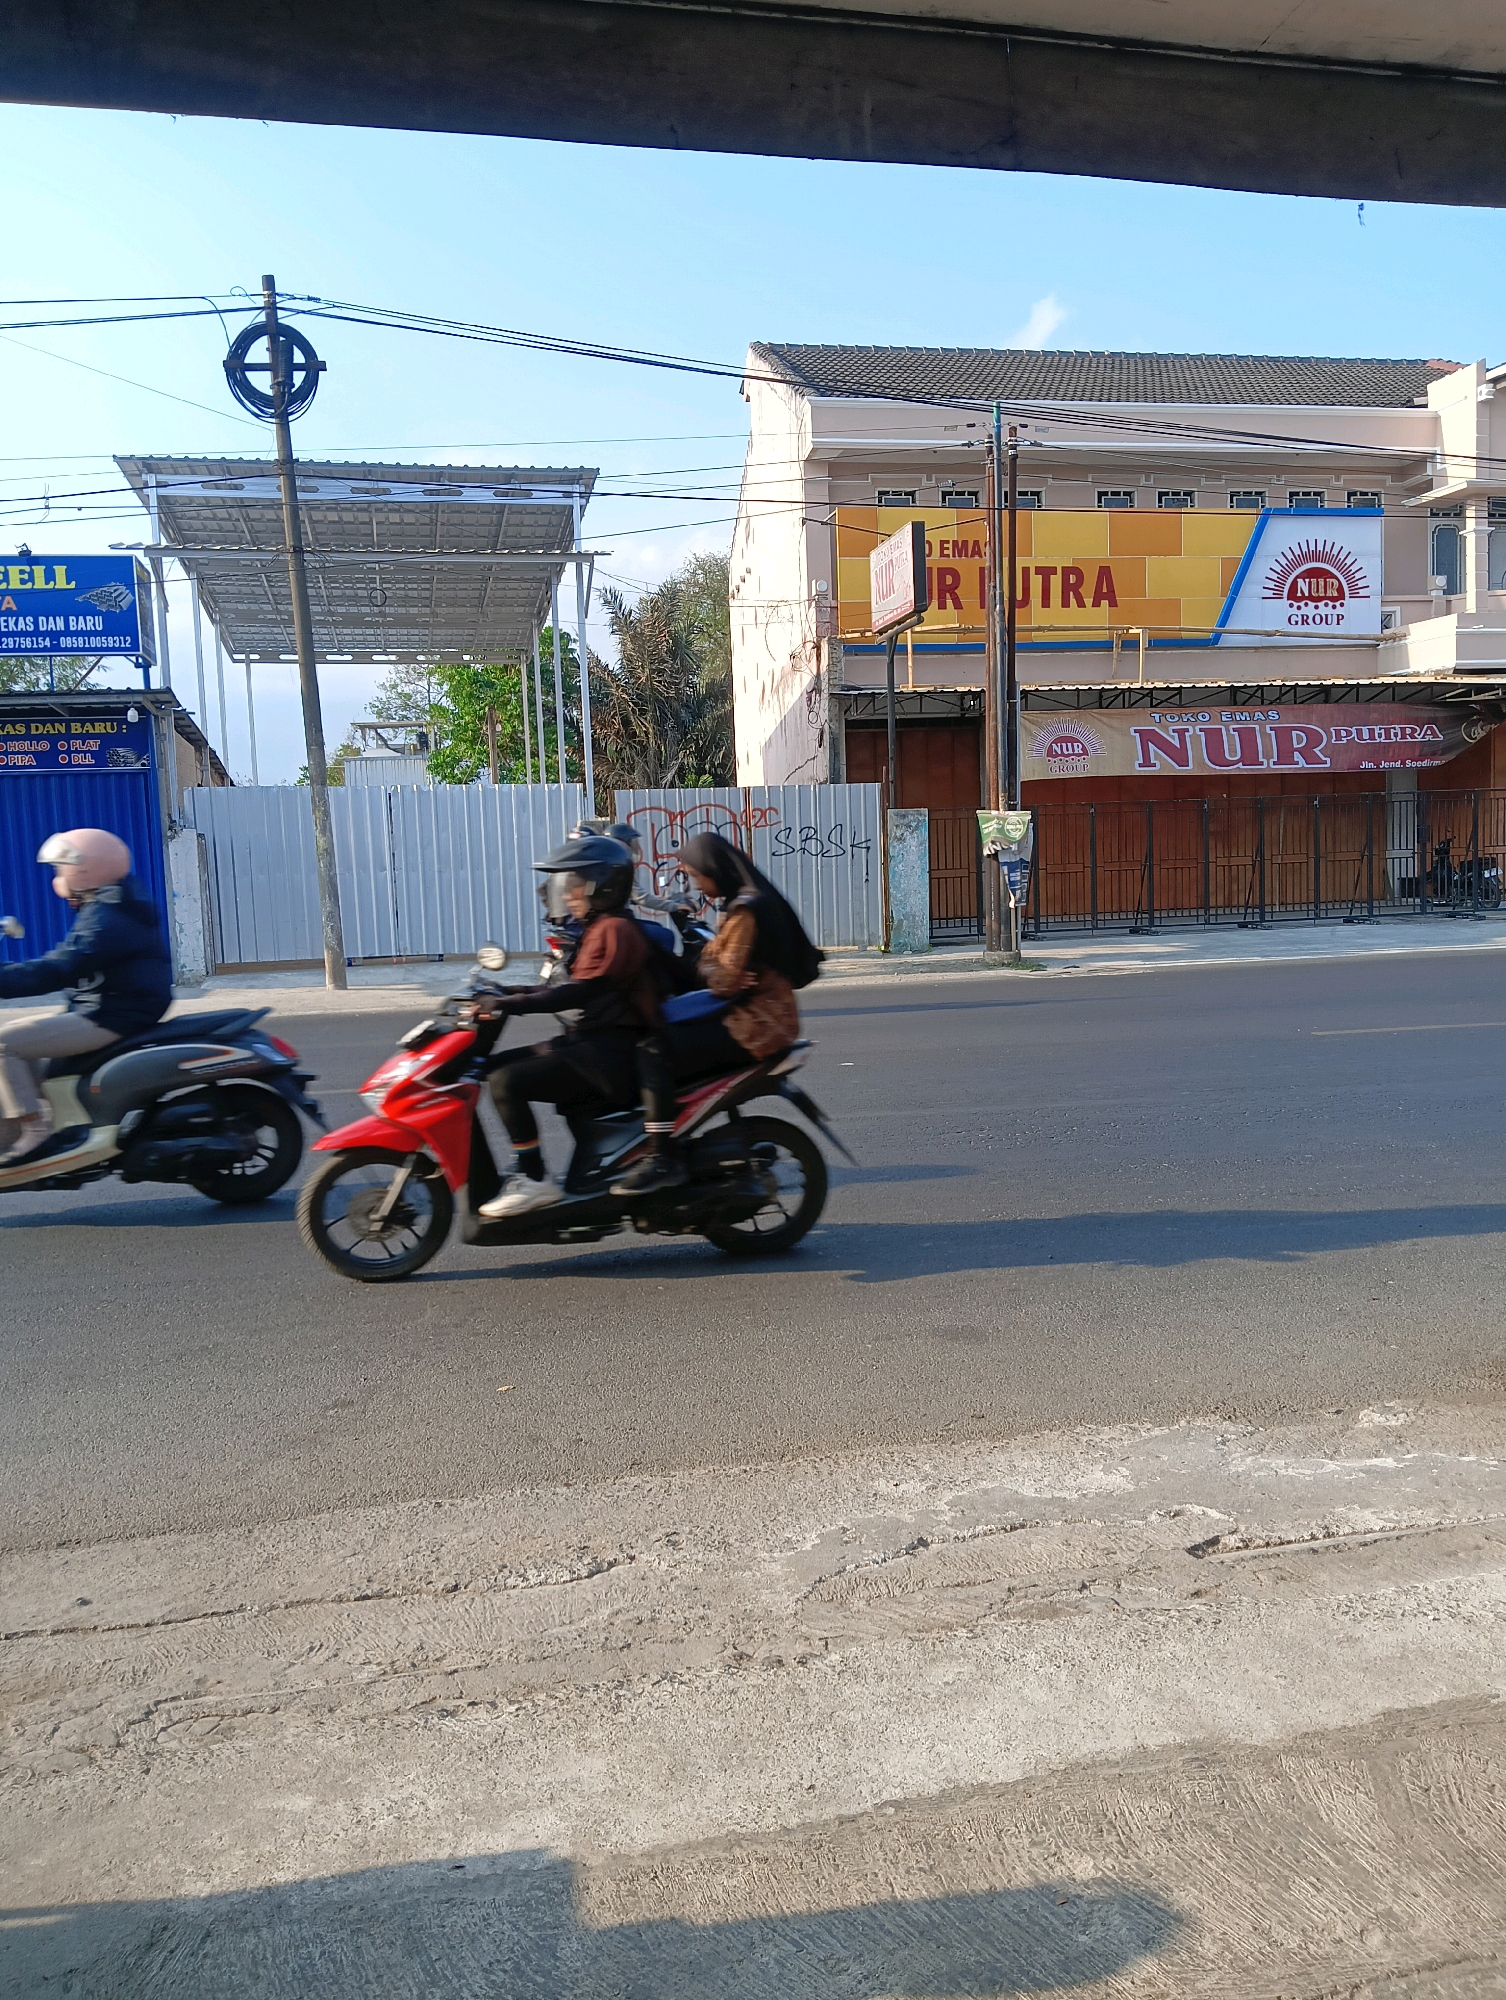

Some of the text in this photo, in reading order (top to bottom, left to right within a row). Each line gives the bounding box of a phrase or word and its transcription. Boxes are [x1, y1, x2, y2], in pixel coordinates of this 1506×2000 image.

[0, 565, 76, 589] ELL
[874, 558, 896, 607] NUR
[1296, 578, 1339, 597] NUR
[0, 595, 17, 611] A
[38, 616, 65, 631] DAN
[68, 616, 103, 631] BARU
[1287, 613, 1345, 626] GROUP
[0, 637, 51, 649] 29756154
[1150, 709, 1281, 723] TOKO EMAS
[30, 723, 66, 734] DAN
[70, 722, 118, 733] BARU
[1330, 724, 1444, 744] PUTRA
[7, 740, 50, 752] HOLLO
[70, 739, 100, 751] PLAT
[1051, 742, 1084, 755] NUR
[1130, 724, 1331, 770] NUR
[8, 754, 36, 766] PIPA
[71, 753, 95, 765] DLL
[1359, 760, 1377, 769] Jln.
[1379, 760, 1404, 769] Jend.
[1049, 763, 1089, 774] GROUP
